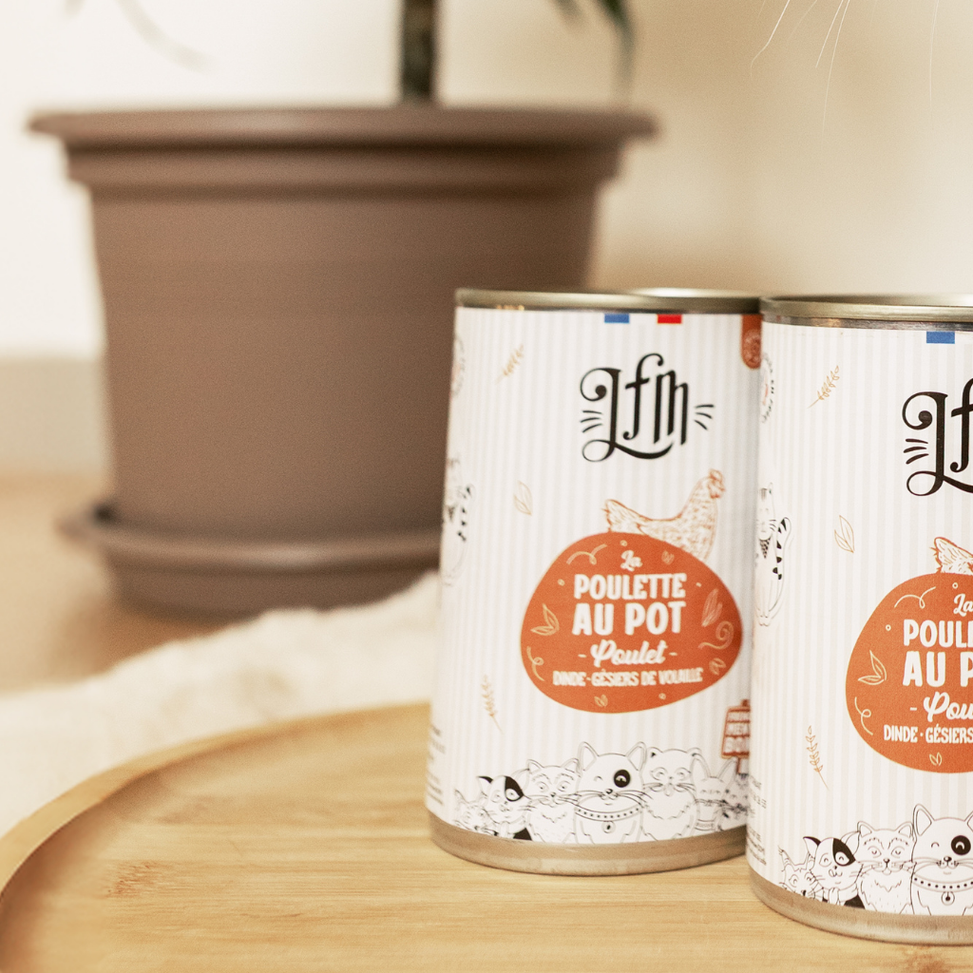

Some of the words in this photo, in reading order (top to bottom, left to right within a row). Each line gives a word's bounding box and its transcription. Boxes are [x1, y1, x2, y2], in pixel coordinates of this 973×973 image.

[620, 550, 643, 572] La
[573, 573, 687, 600] POULETTE
[571, 602, 614, 636] AU
[624, 601, 687, 635] POT
[590, 639, 668, 667] Poulet
[552, 670, 587, 686] DINDE
[640, 670, 656, 686] DE
[902, 651, 946, 687] AU
[883, 724, 918, 743] DINDE
